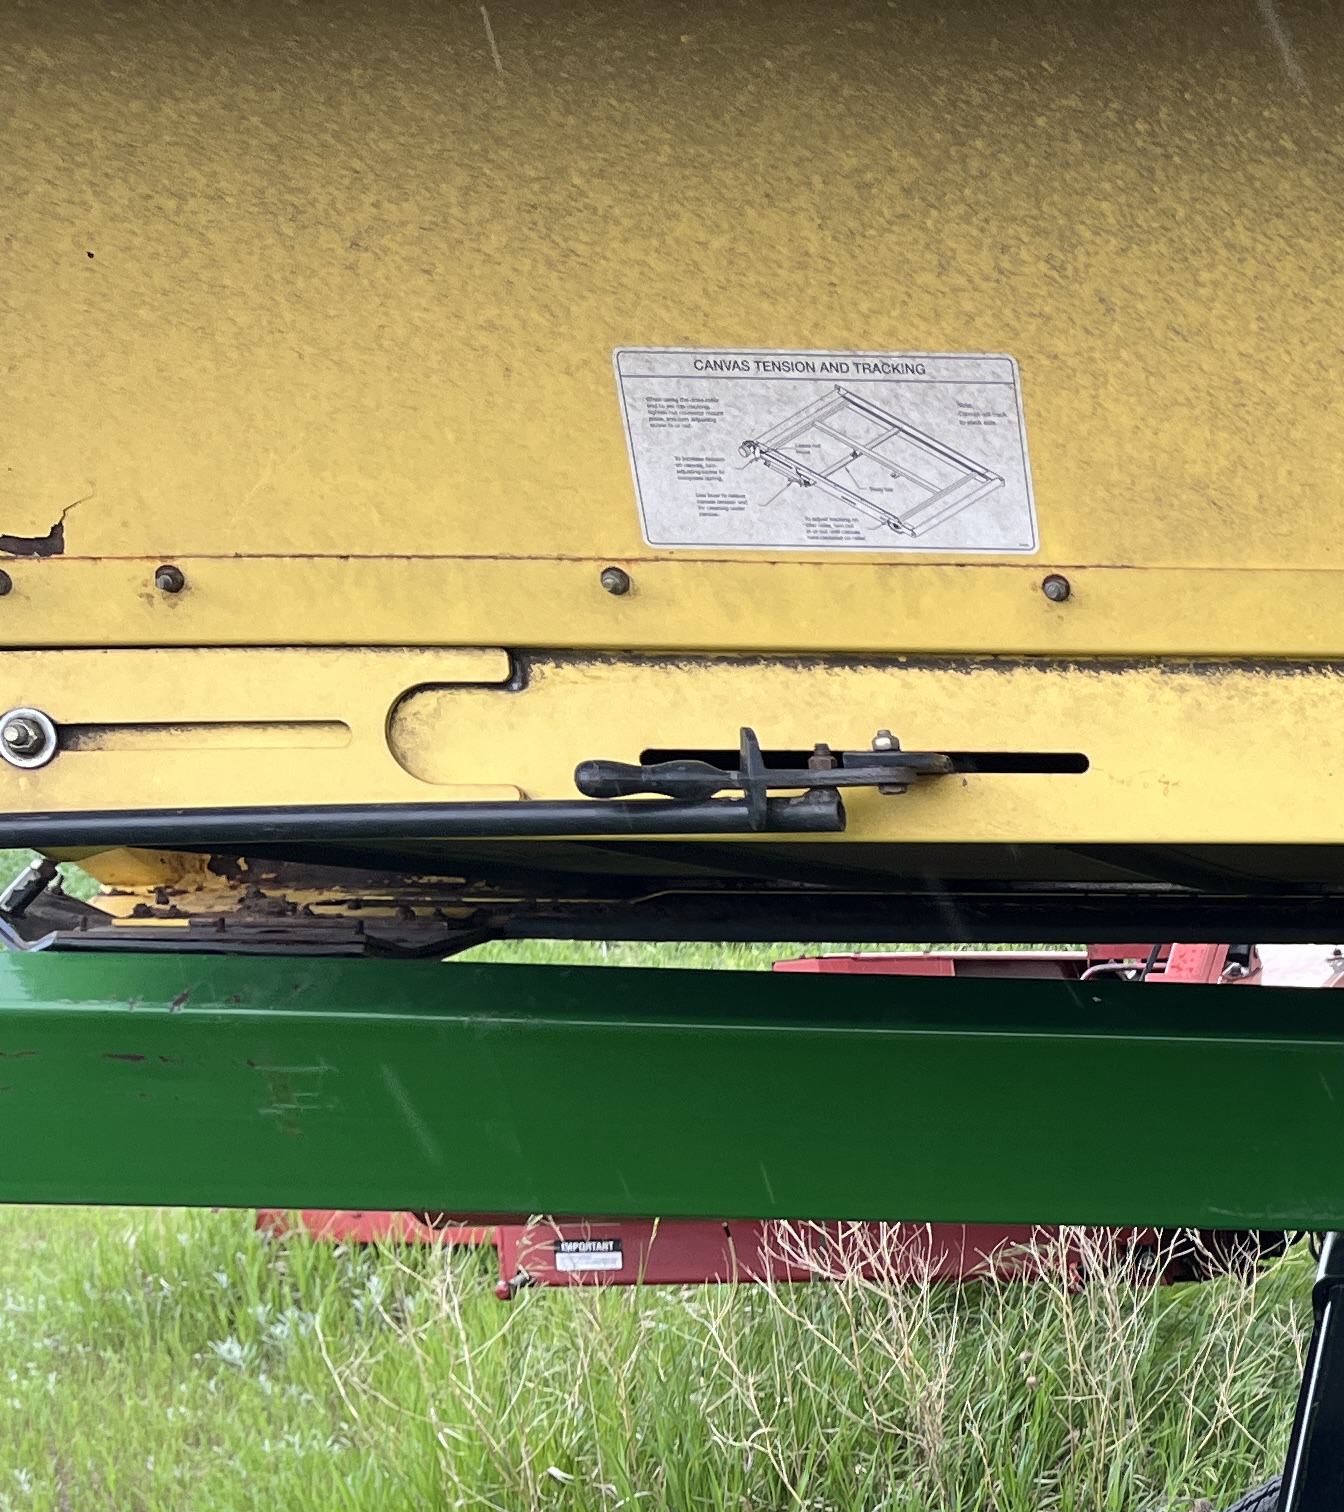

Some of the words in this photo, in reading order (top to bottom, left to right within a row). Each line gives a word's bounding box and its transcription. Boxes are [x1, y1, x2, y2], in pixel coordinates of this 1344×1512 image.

[694, 359, 751, 372] CANVAS
[756, 360, 815, 374] TENSION
[819, 361, 850, 374] AND
[853, 361, 926, 376] TRACKING
[561, 1240, 614, 1252] IMPORTANT
